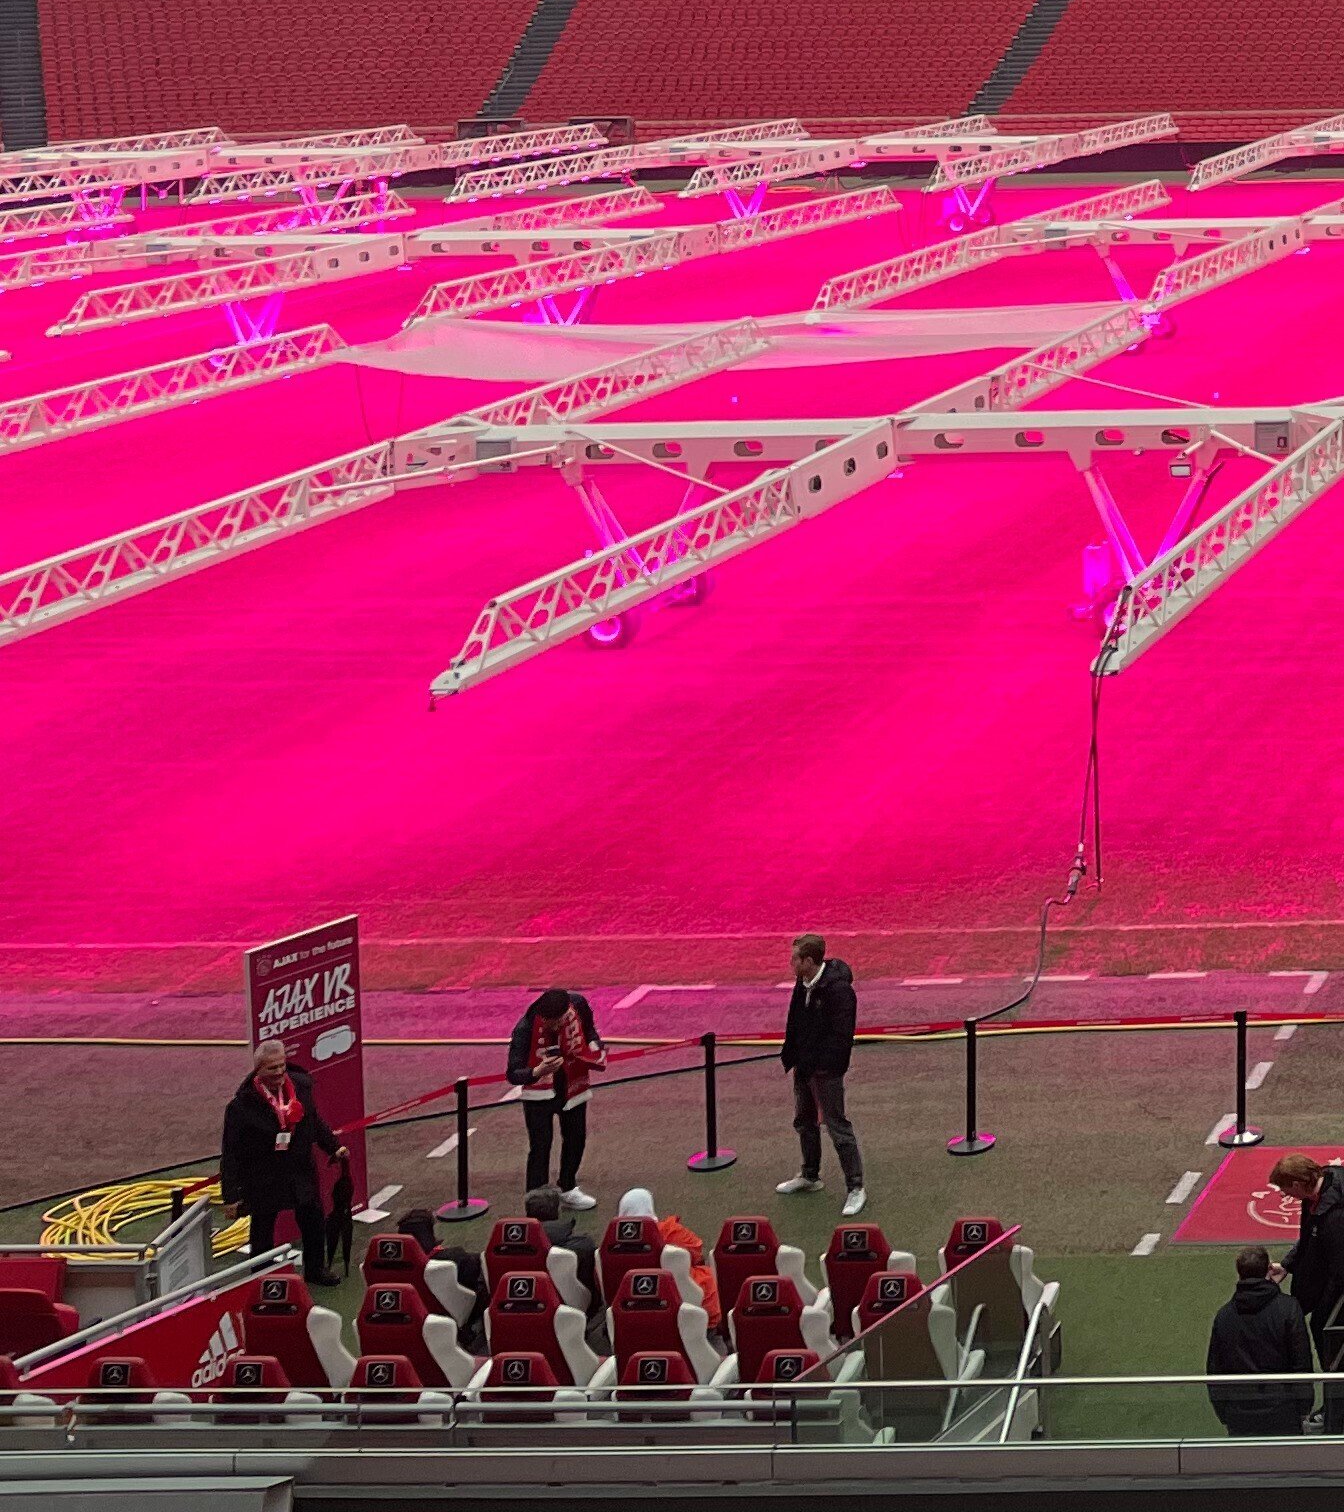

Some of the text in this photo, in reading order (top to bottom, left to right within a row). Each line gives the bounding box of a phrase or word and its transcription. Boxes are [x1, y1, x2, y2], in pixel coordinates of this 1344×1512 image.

[273, 952, 299, 969] AJAX
[258, 963, 355, 1023] AJAX VR
[259, 995, 355, 1041] EXPERIENCE
